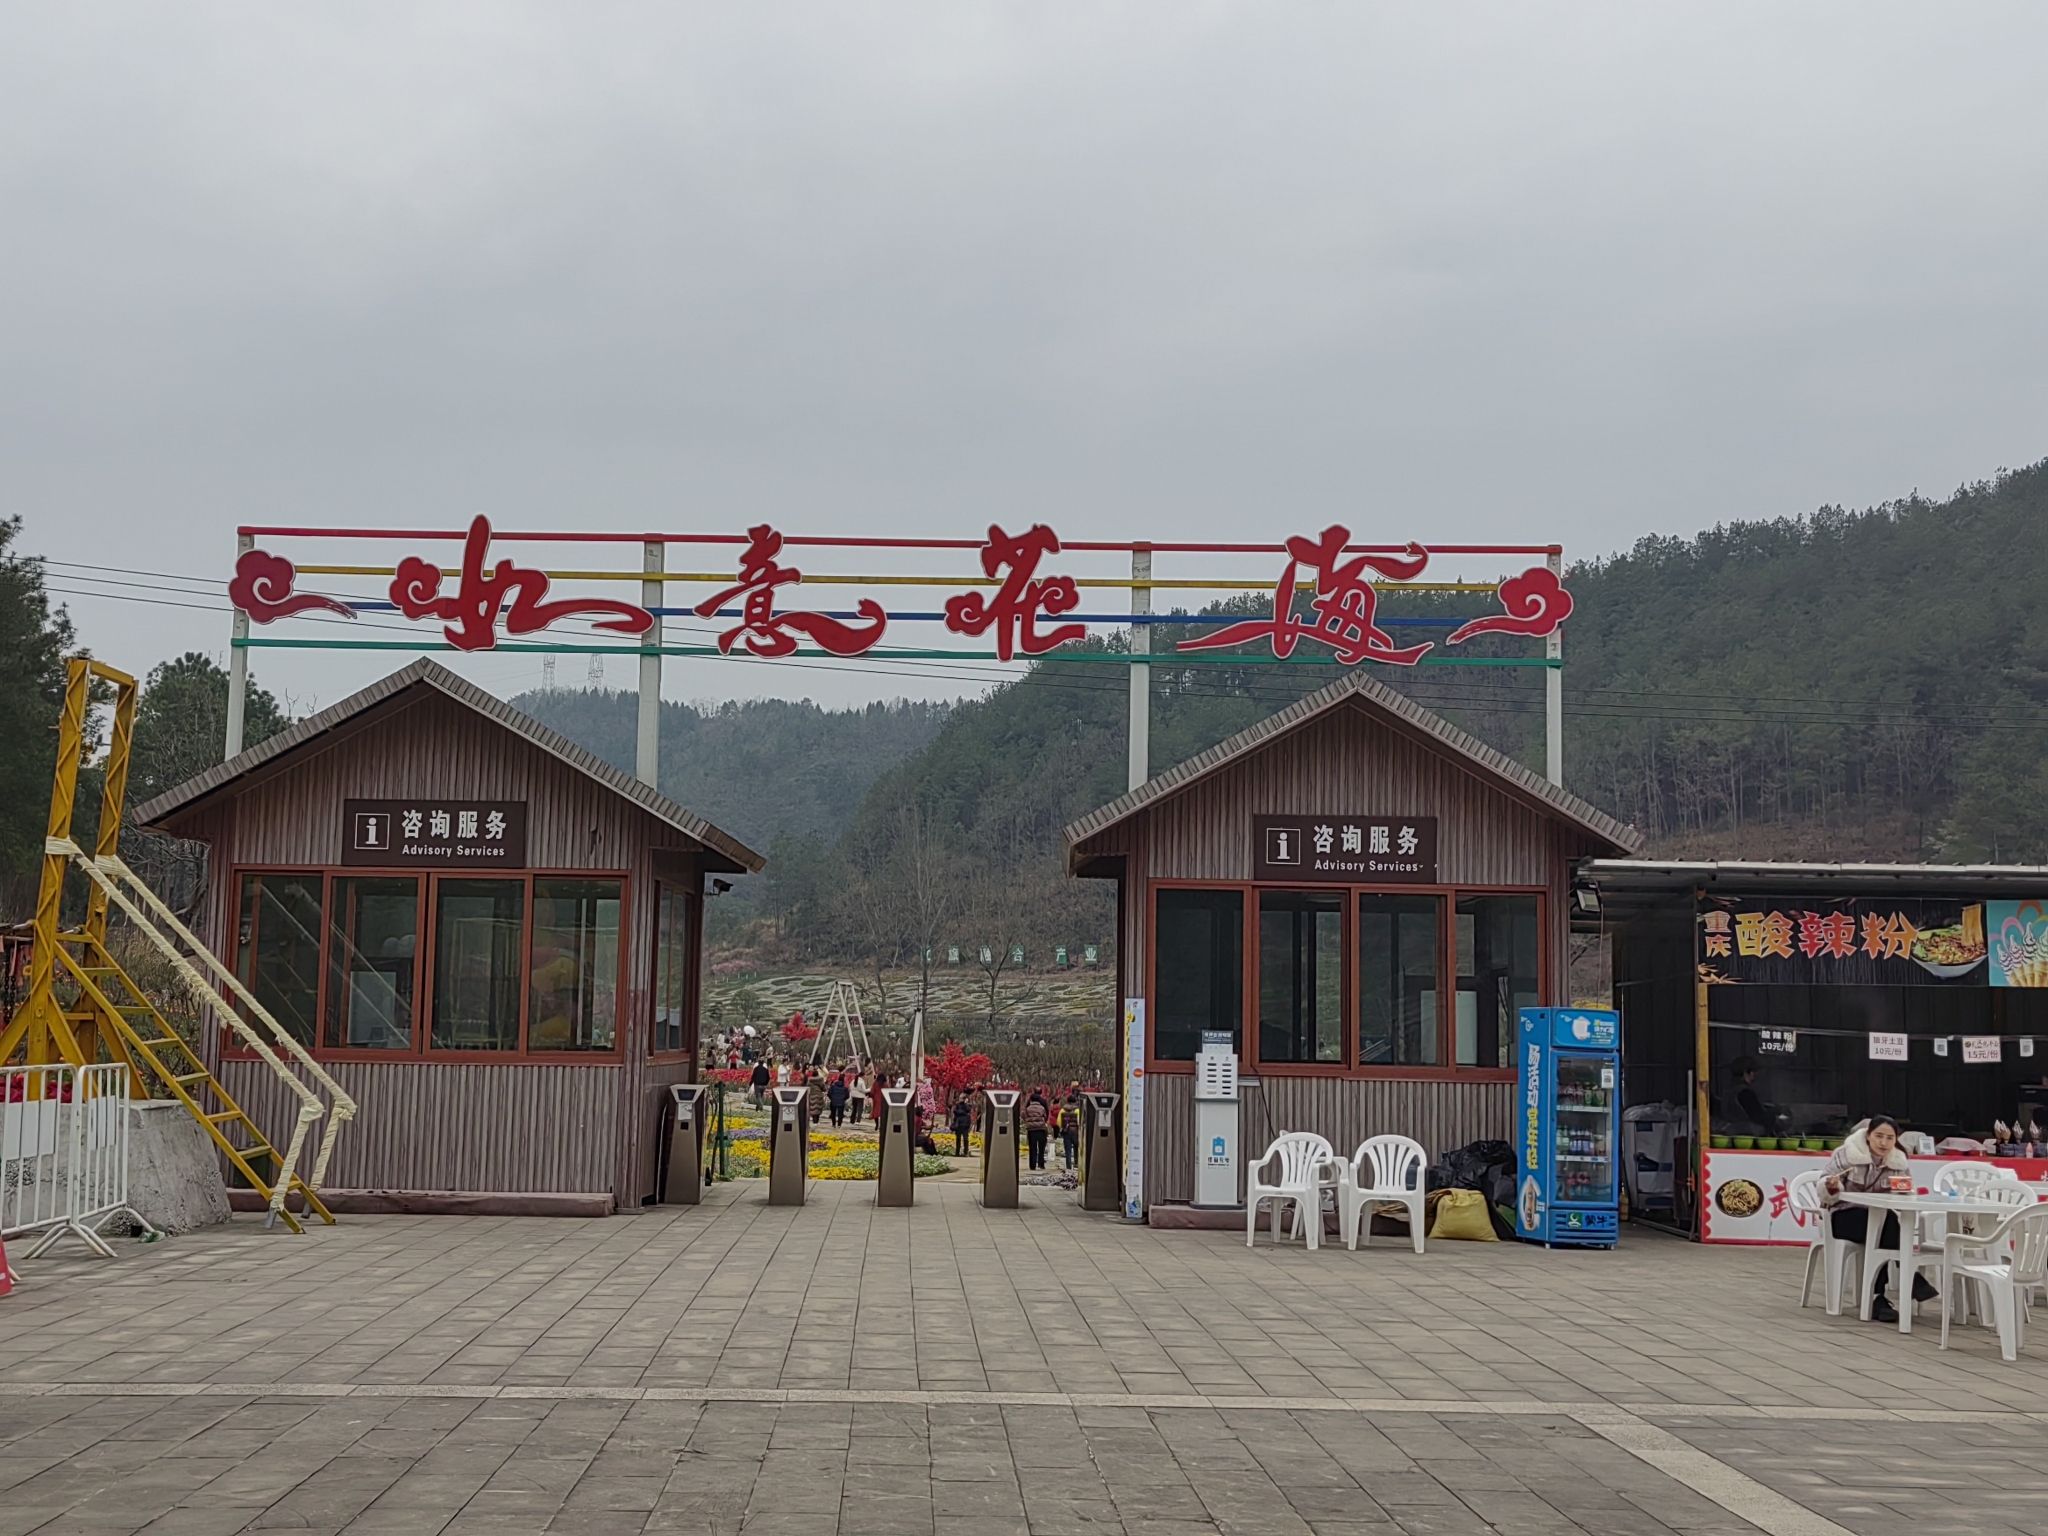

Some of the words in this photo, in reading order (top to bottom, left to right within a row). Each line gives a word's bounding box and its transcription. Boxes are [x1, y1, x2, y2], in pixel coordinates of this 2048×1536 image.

[390, 514, 1435, 666] 如意花海
[401, 809, 507, 840] 咨询服务
[1313, 824, 1419, 855] 咨询服务
[402, 844, 452, 857] Advisory
[457, 845, 505, 856] Services
[1314, 859, 1365, 872] Advisory
[1369, 860, 1418, 872] Services
[1704, 910, 1732, 958] 重庆
[1735, 910, 1920, 960] 酸辣粉
